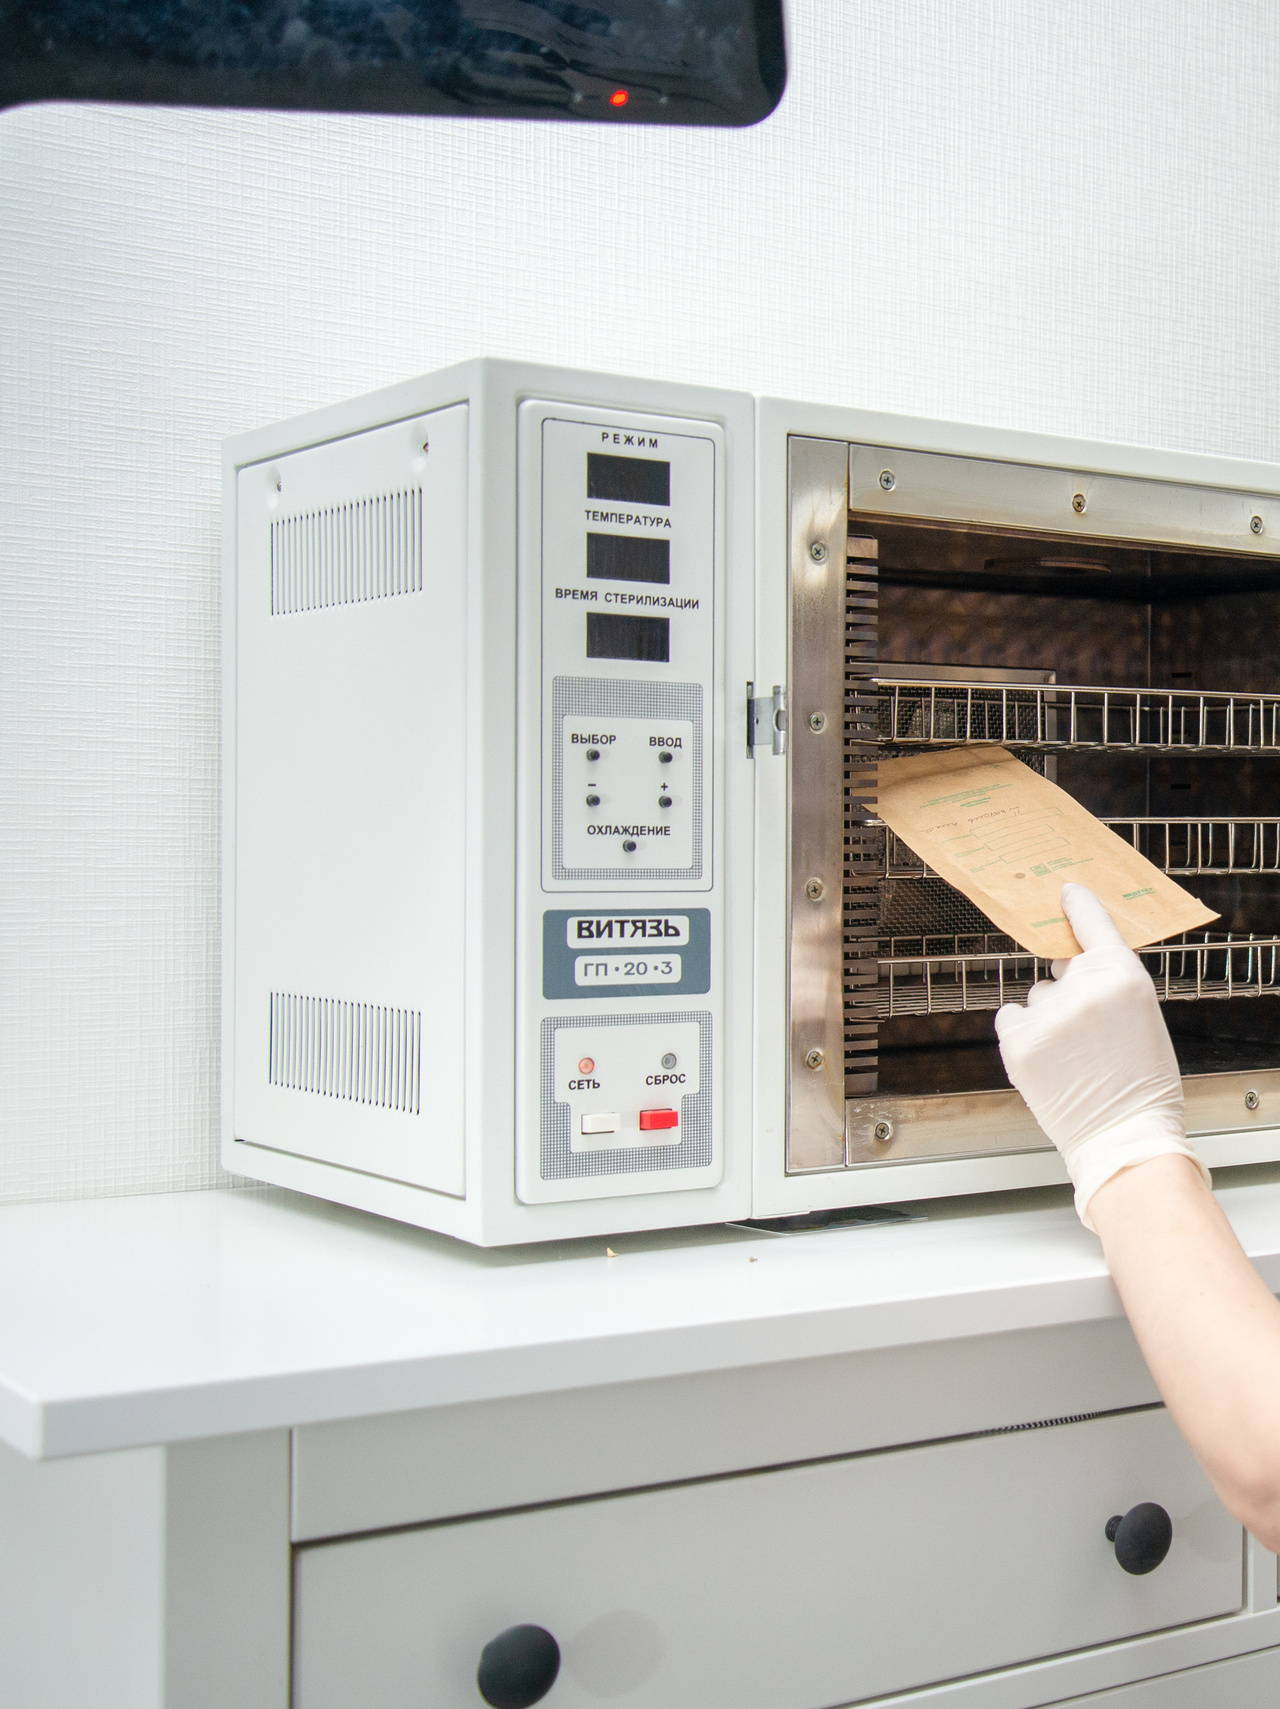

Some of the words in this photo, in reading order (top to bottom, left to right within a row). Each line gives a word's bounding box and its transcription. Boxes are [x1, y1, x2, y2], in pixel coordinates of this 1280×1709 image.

[601, 432, 658, 449] РЕЖИМ
[584, 510, 672, 528] ТЕМПЕРАТУРА
[555, 588, 598, 601] ВРЕМЯ
[604, 592, 700, 610] СТЕРИЛИЗАЦИИ
[571, 733, 616, 745] ВЫБОР
[649, 737, 682, 749] ВВОД
[587, 825, 671, 837] ОХЛАЖДЕНИЕ
[576, 919, 681, 939] ВИТЯЗЬ
[568, 1079, 601, 1091] СЕТЬ
[645, 1073, 686, 1086] СБРОС
